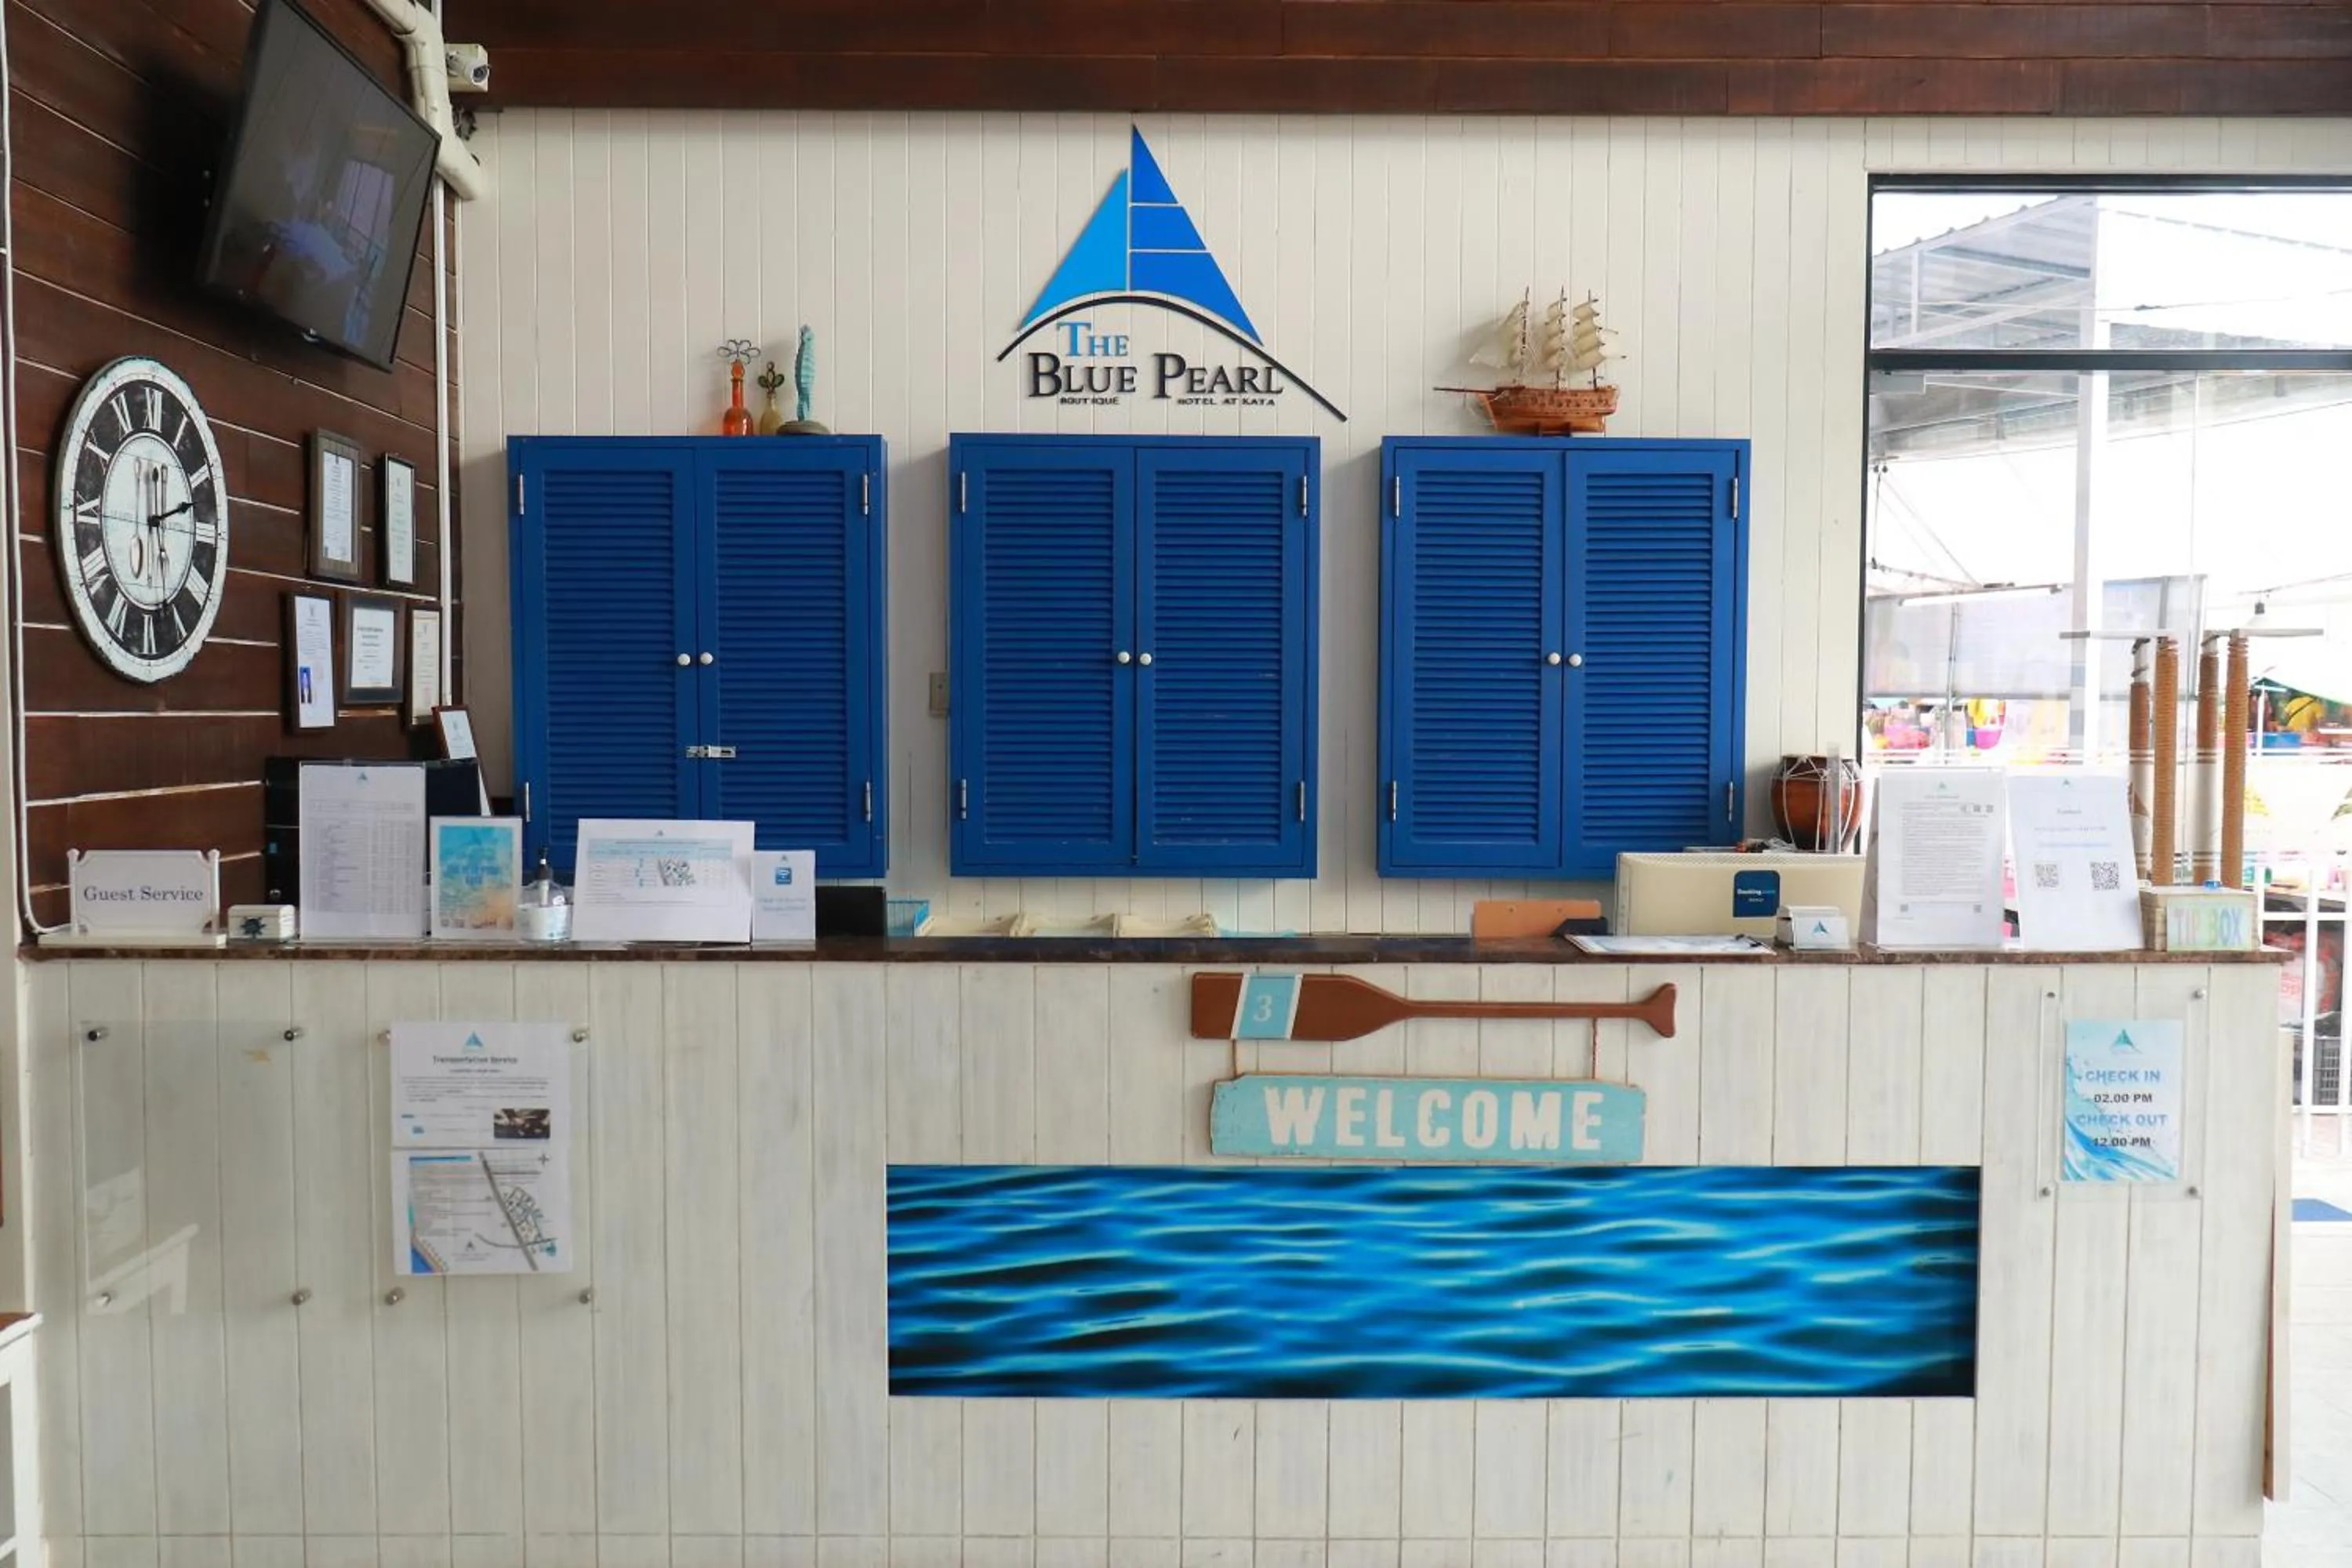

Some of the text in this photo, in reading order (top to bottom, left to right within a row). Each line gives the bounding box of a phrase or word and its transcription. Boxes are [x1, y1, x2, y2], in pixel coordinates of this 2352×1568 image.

[1056, 321, 1130, 358] THE
[1028, 352, 1283, 399] BLUE PEARL
[1060, 397, 1120, 405] BOUTIQUE
[83, 885, 204, 902] Guest Service
[2174, 906, 2242, 946] TIP BOX
[1253, 994, 1272, 1022] 3
[2085, 1070, 2161, 1083] CHECK IN
[2093, 1094, 2153, 1103] 02.00 PM
[1264, 1086, 1604, 1150] WELCOME
[2078, 1114, 2168, 1127] CHECK OUT
[2093, 1138, 2151, 1148] 12.00 PM
